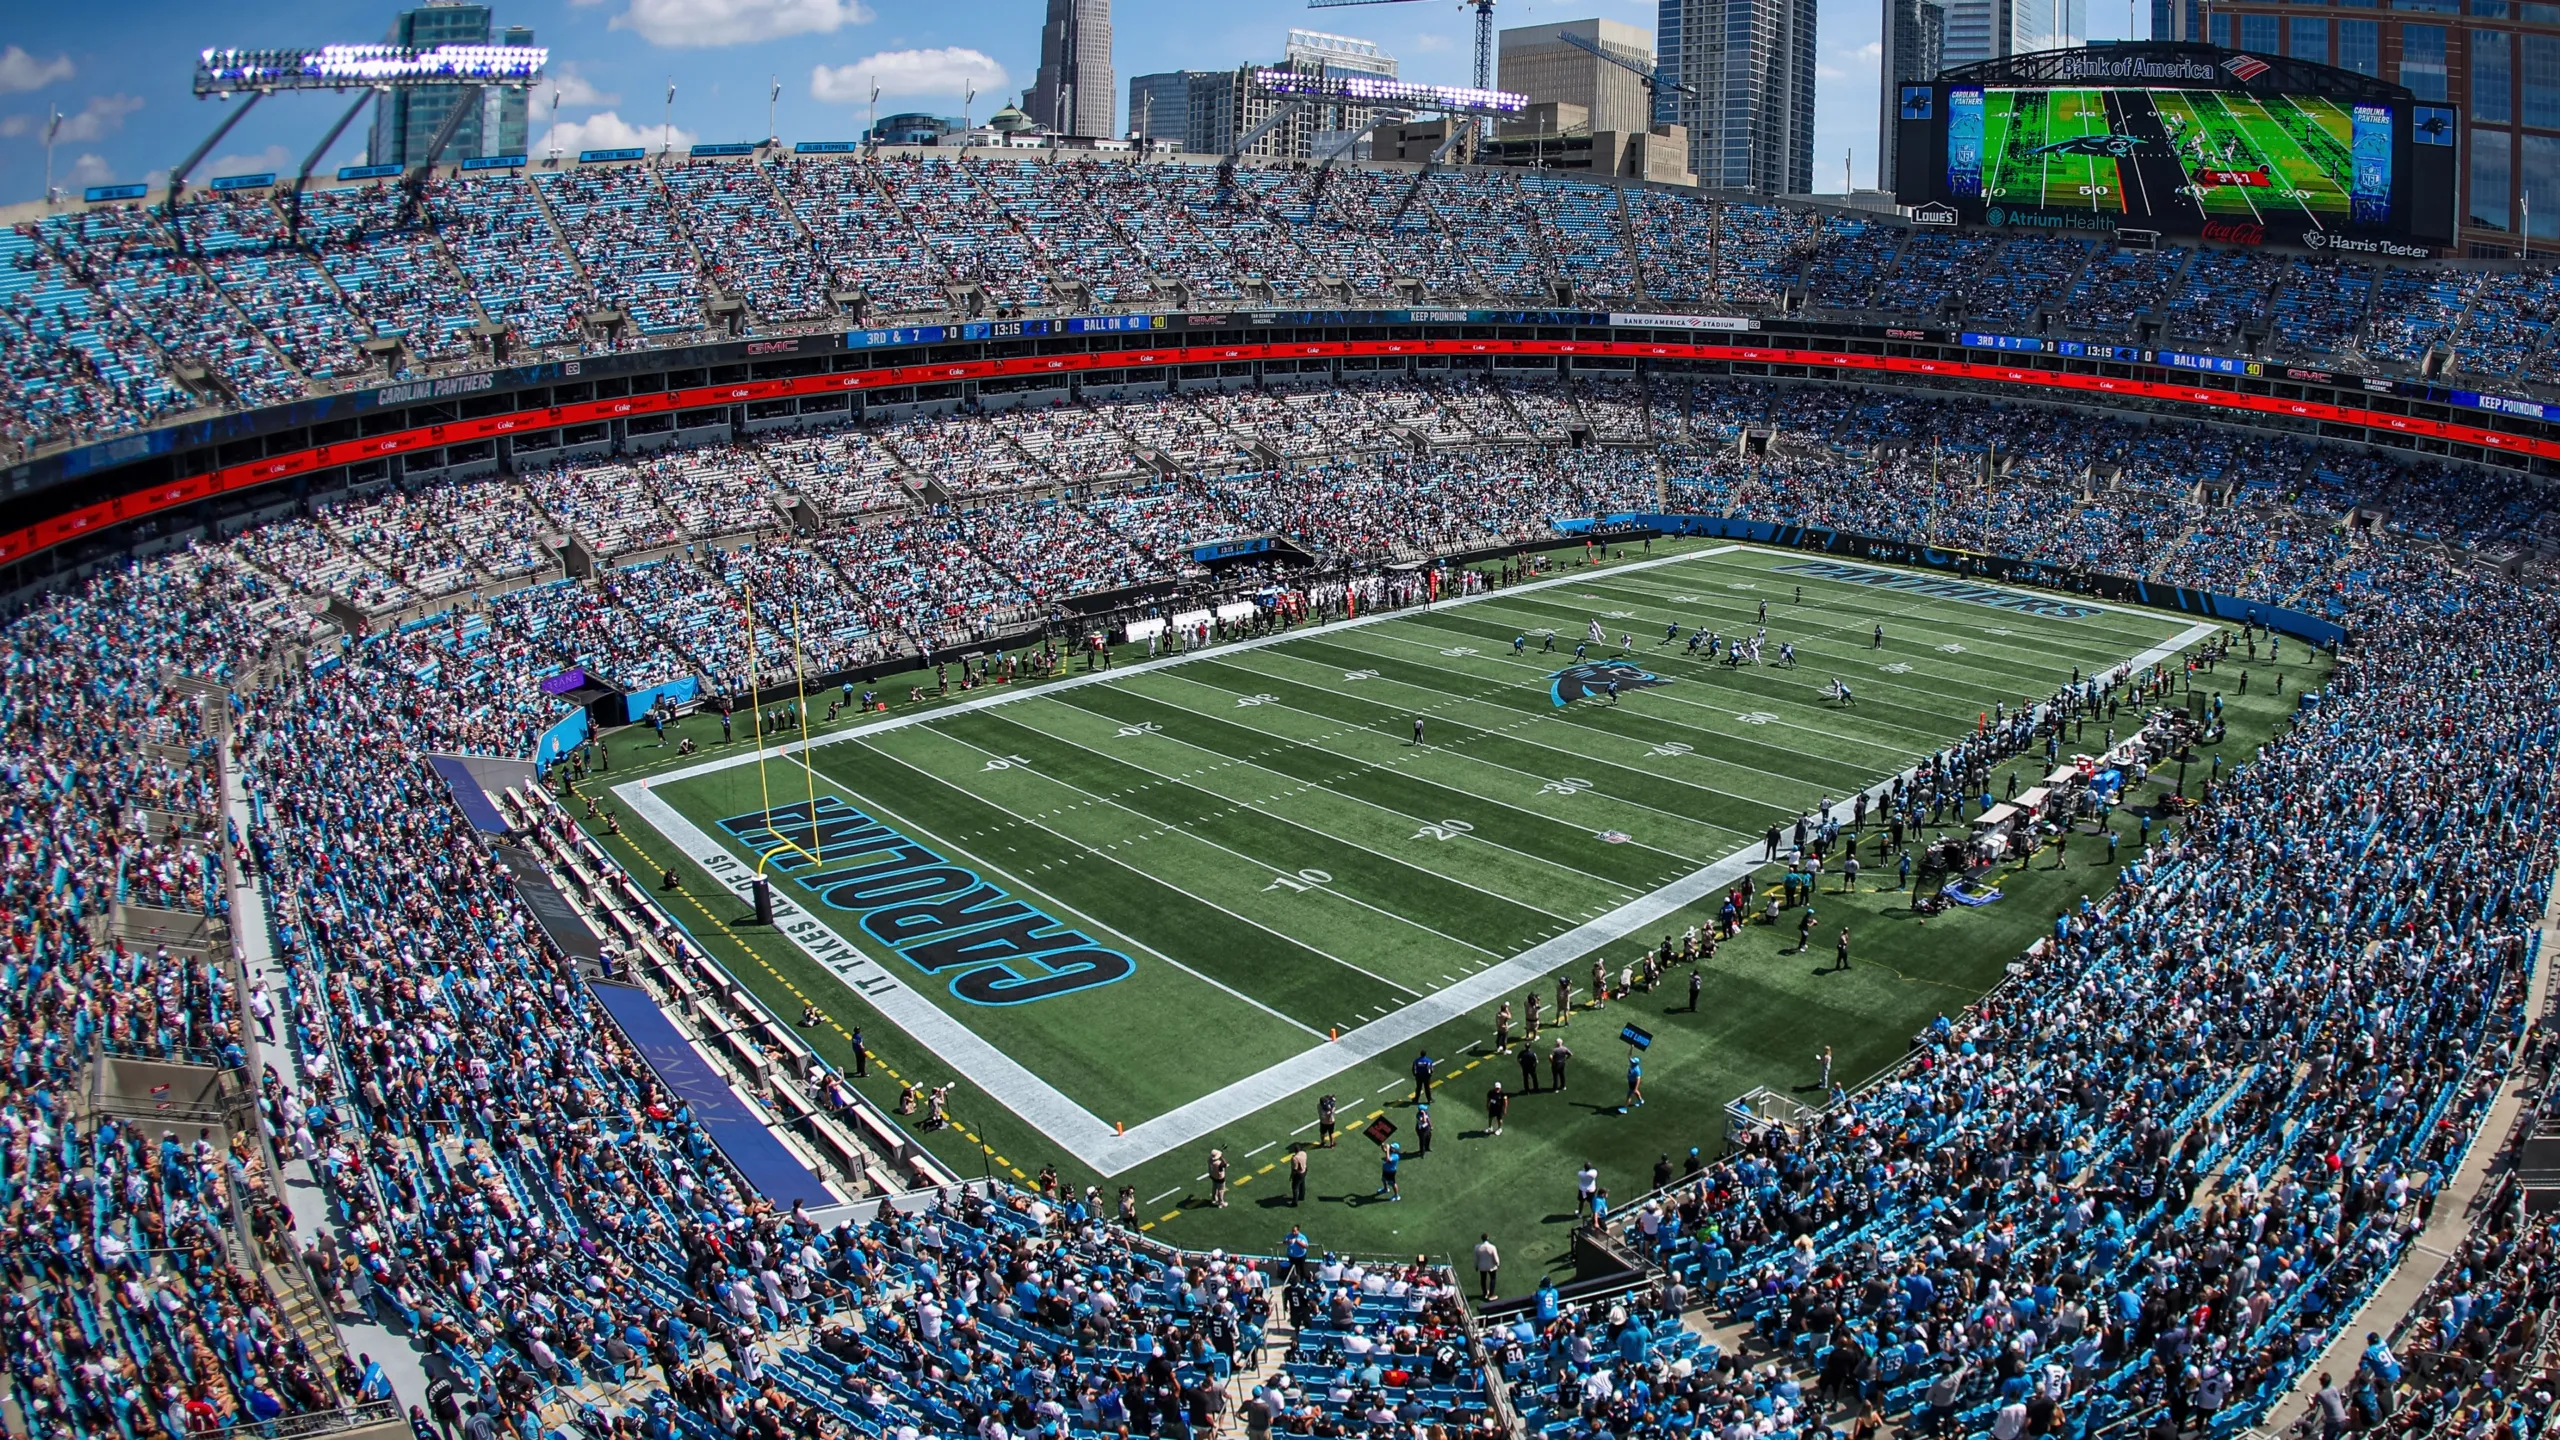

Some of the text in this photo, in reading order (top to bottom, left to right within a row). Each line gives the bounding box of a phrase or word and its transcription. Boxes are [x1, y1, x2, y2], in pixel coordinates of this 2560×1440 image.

[2062, 56, 2214, 80] Bank of America
[2354, 107, 2385, 117] CAROLINA
[2357, 115, 2390, 125] PANTHERS
[2362, 173, 2380, 186] NFL
[2079, 186, 2108, 196] 50
[1916, 209, 1953, 223] LOWE'S
[2008, 211, 2115, 231] Atrium Health
[2328, 234, 2429, 259] Harris Teeter
[1152, 315, 1165, 328] 40
[1187, 315, 1227, 326] GMC
[1411, 311, 1467, 323] KEEP POUNDING
[994, 322, 1021, 336] 13:15
[1054, 320, 1061, 332] 0
[1083, 317, 1139, 331] BALL ON 40
[1655, 319, 1686, 327] AMERICA
[1702, 321, 1735, 329] STADIUM
[866, 329, 920, 345] 3RD & 7
[950, 326, 957, 338] 0
[1886, 329, 1924, 340] GMC
[747, 340, 799, 355] GMC
[1977, 335, 2022, 348] 3RD & 7
[2047, 341, 2054, 352] 0
[2087, 345, 2112, 357] 13:15
[2145, 351, 2152, 362] 0
[2173, 355, 2232, 371] BALL ON 40
[2246, 363, 2260, 376] 40
[948, 368, 965, 376] Coke
[2287, 369, 2332, 383] GMC
[843, 377, 860, 386] Coke
[2099, 381, 2114, 389] Coke
[377, 373, 493, 406] CAROLINA PANTHERS
[731, 389, 749, 398] Coke
[2194, 392, 2209, 400] Coke
[614, 403, 631, 412] Coke
[2291, 405, 2307, 413] Coke
[2479, 395, 2543, 418] KEEP POUNDING
[497, 421, 515, 430] Coke
[2391, 420, 2406, 428] Coke
[380, 441, 397, 450] Coke
[2485, 435, 2500, 444] Coke
[270, 464, 285, 473] Coke
[1770, 562, 2104, 620] PANTHERS
[1237, 693, 1280, 706] 30
[1117, 721, 1163, 736] 20
[1652, 741, 1694, 756] 40
[986, 753, 1032, 770] 10
[1543, 777, 1594, 795] 30
[1419, 819, 1474, 841] 20
[703, 854, 738, 873] US
[725, 874, 754, 892] OF
[1274, 868, 1332, 894] 10
[715, 795, 1136, 1007] CAROLINA
[787, 921, 865, 974] TAKES
[855, 975, 898, 996] IT
[1622, 1027, 1650, 1047] GET LOUD
[1214, 1325, 1222, 1338] 9
[1506, 1348, 1523, 1364] 84
